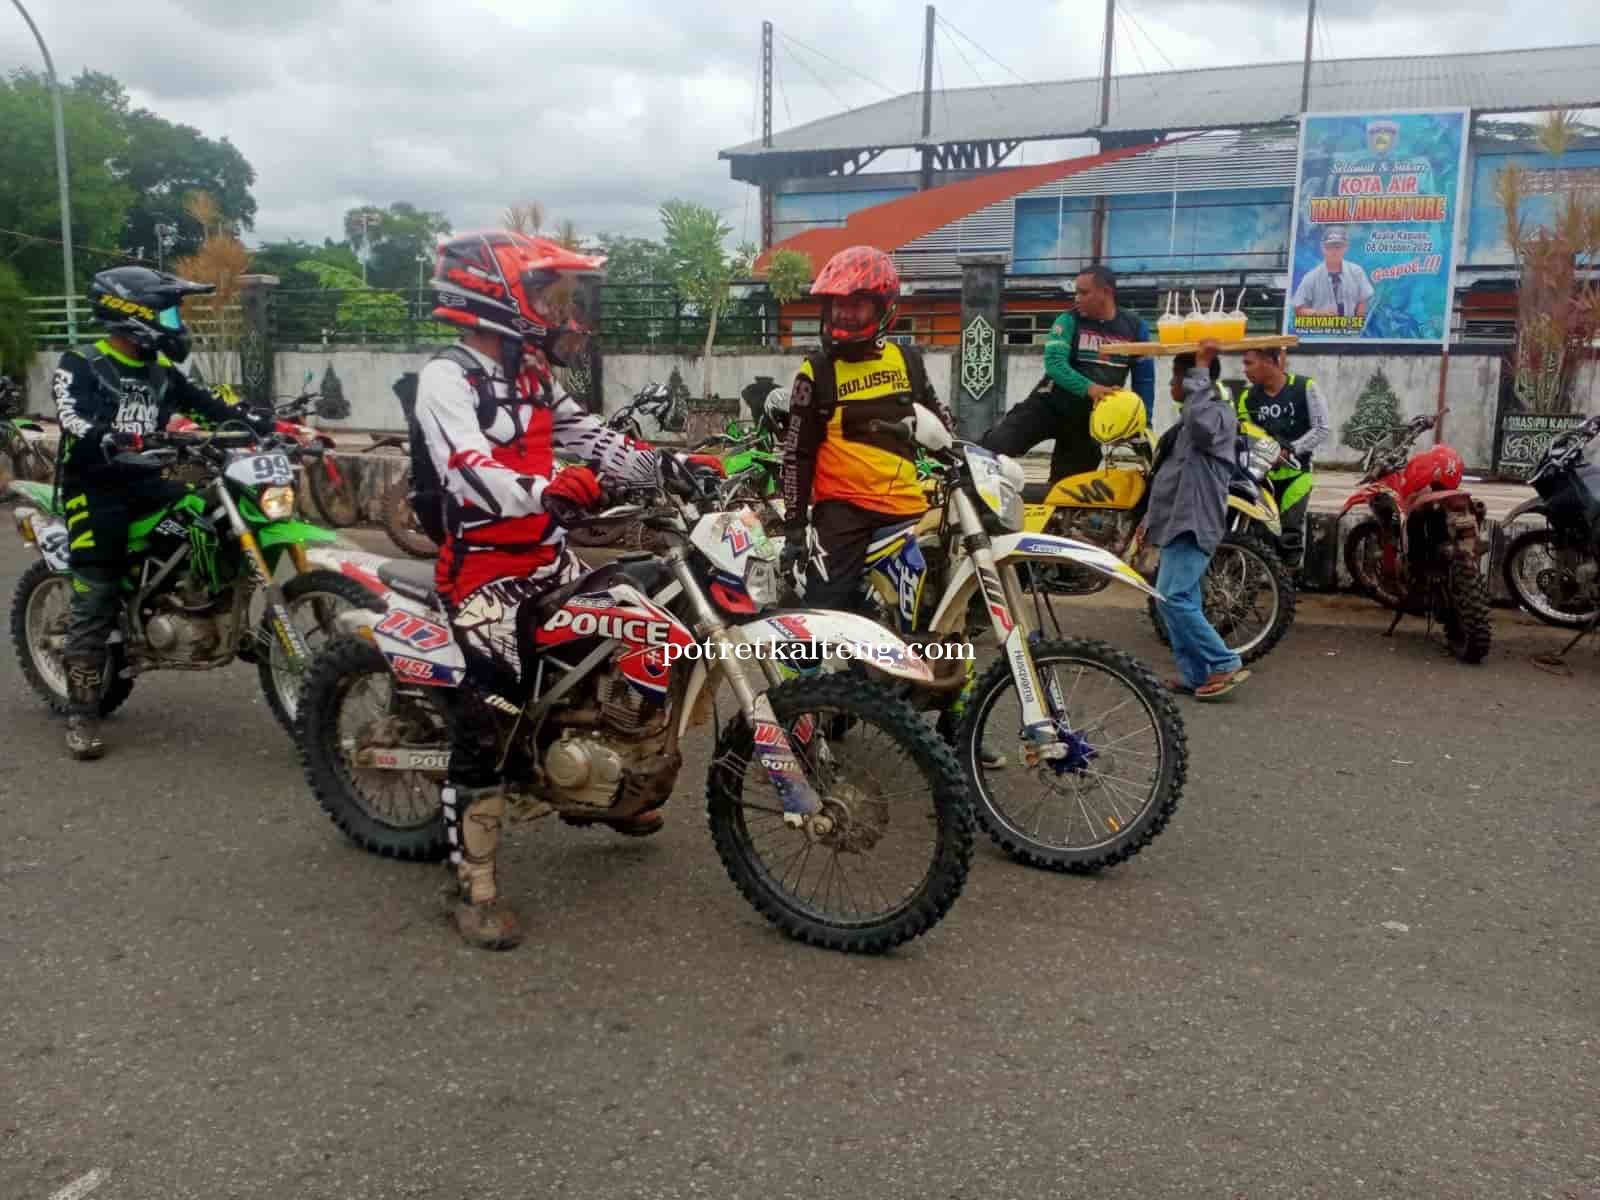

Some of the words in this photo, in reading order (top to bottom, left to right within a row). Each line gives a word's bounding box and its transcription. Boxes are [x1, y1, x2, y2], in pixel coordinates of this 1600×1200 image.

[1339, 176, 1382, 194] KOTA
[1388, 175, 1418, 193] AIR
[1353, 196, 1446, 221] ADVENTURE
[252, 455, 290, 479] 99
[544, 609, 670, 646] POLICE
